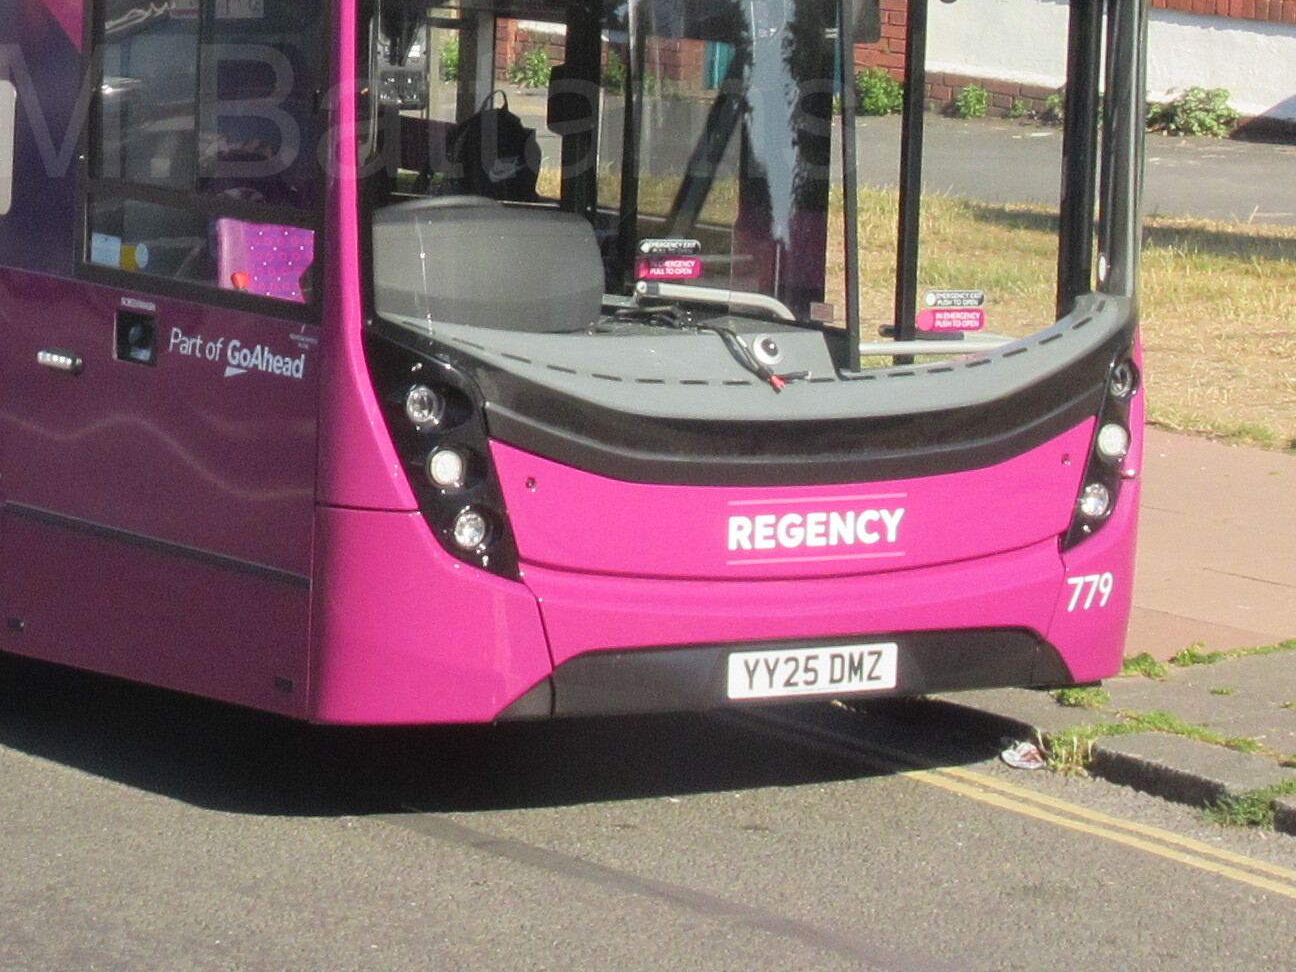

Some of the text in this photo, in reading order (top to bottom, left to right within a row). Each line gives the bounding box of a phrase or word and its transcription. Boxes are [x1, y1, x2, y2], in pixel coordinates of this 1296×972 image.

[168, 327, 203, 359] Part
[205, 337, 225, 362] of
[226, 339, 306, 380] GoAhead
[727, 508, 905, 551] REGENCY
[1066, 572, 1114, 612] 779
[743, 649, 884, 691] YY25 DMZ
